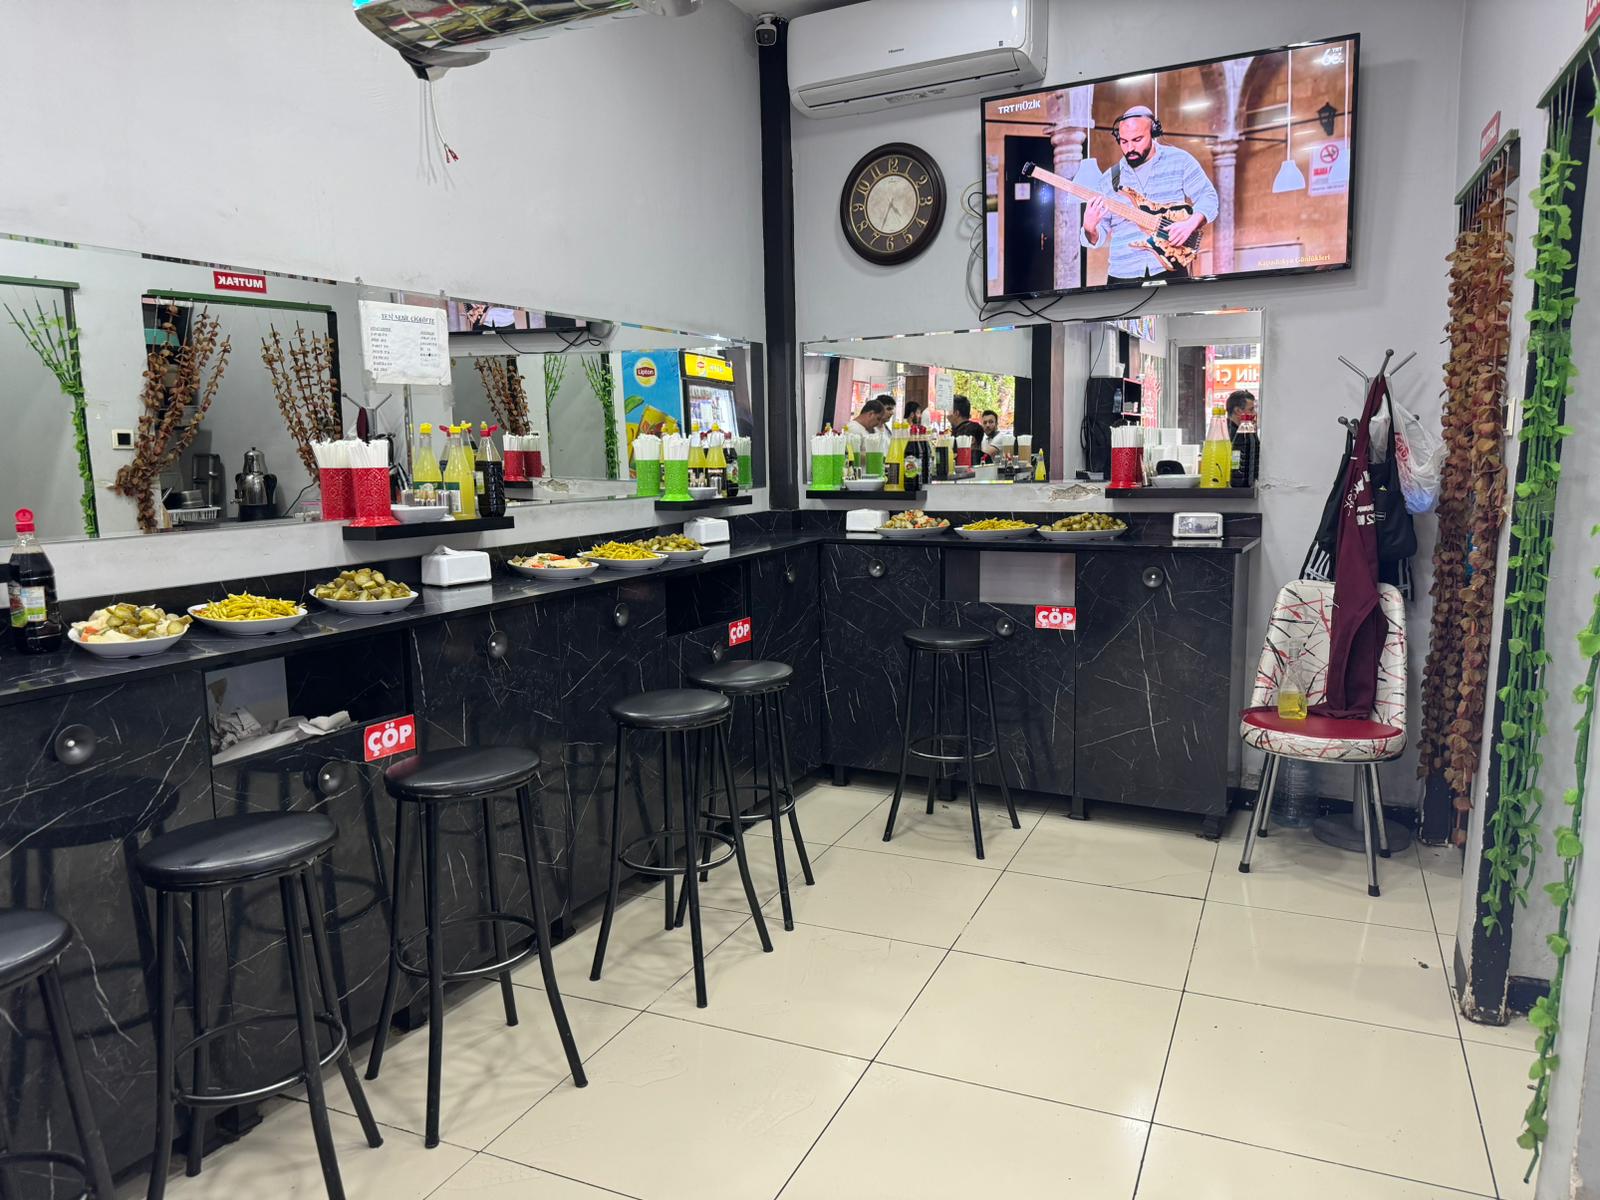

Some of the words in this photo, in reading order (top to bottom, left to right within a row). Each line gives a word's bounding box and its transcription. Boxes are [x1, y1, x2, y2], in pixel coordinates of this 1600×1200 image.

[998, 104, 1015, 114] TRT
[637, 368, 655, 376] Lipton
[1037, 607, 1074, 627] ÇÖP
[730, 621, 750, 644] ÇÖP
[367, 722, 413, 757] ÇÖP
